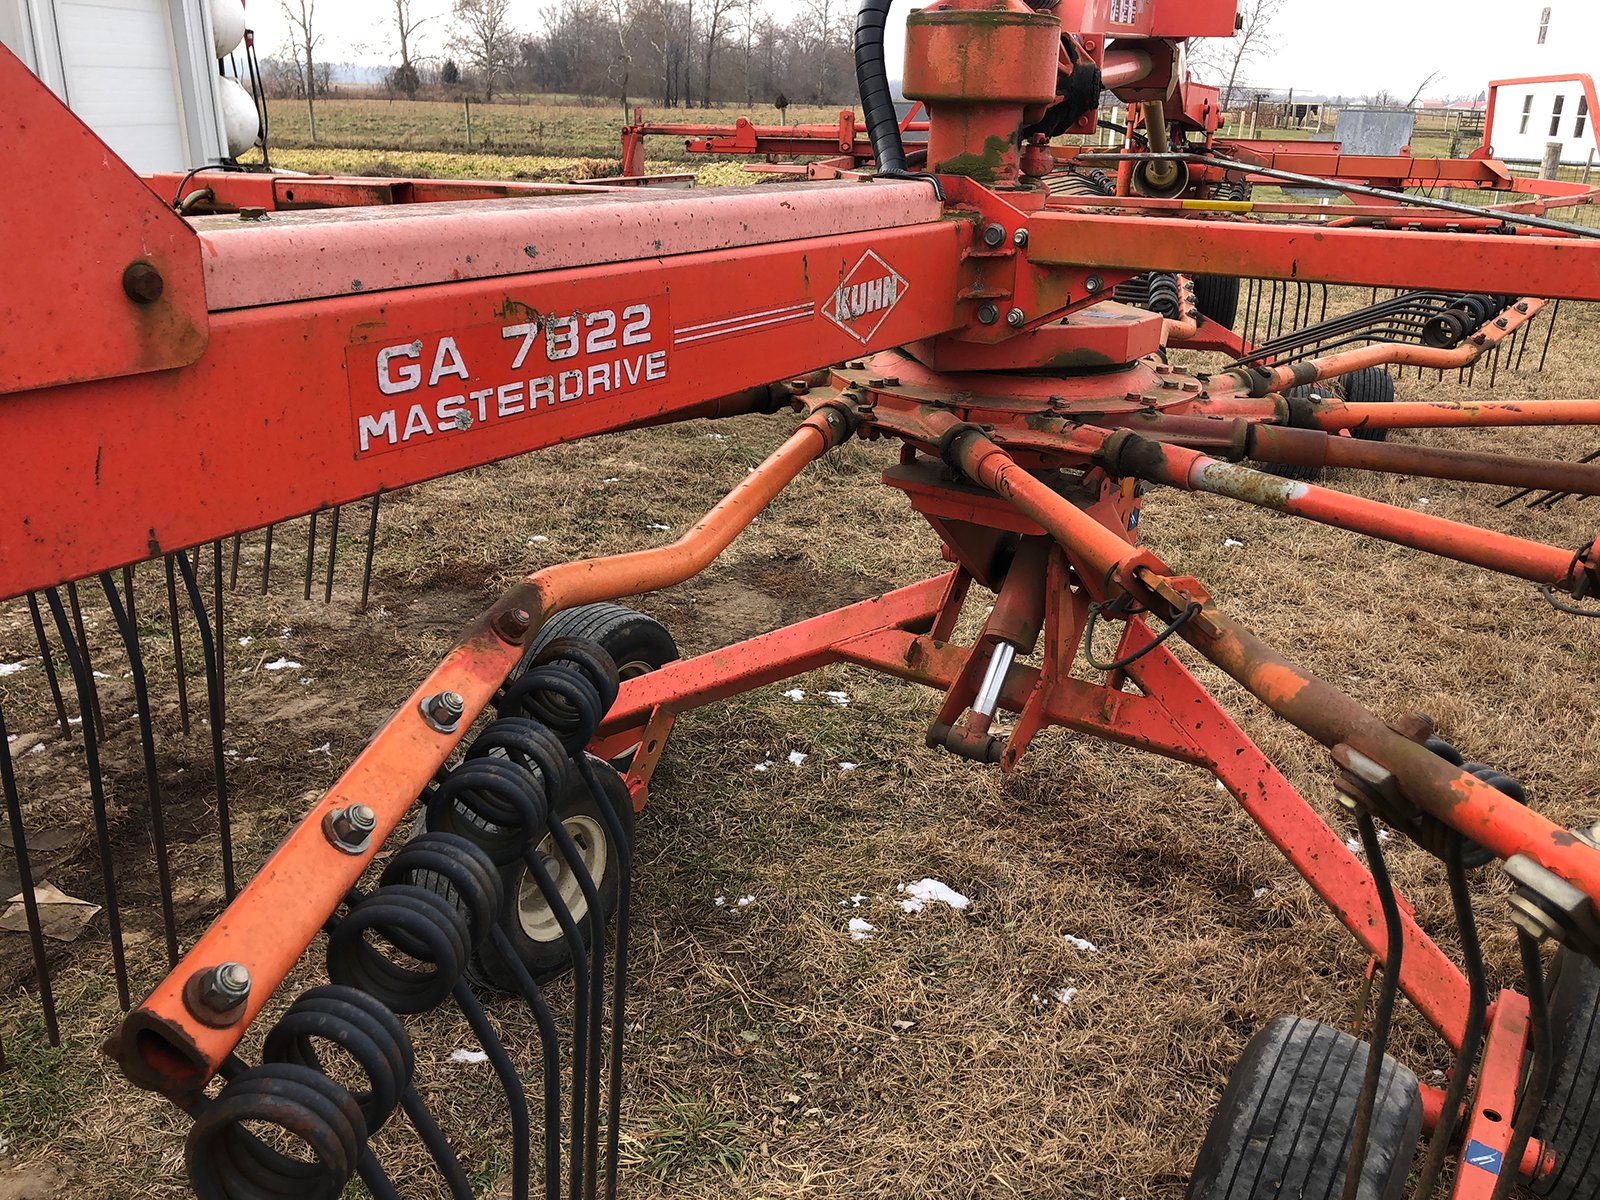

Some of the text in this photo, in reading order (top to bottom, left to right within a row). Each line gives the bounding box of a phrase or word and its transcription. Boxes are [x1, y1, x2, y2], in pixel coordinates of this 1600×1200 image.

[837, 276, 898, 321] KUHN
[377, 303, 652, 394] GA 7822
[359, 350, 667, 450] MASTERDRIVE
